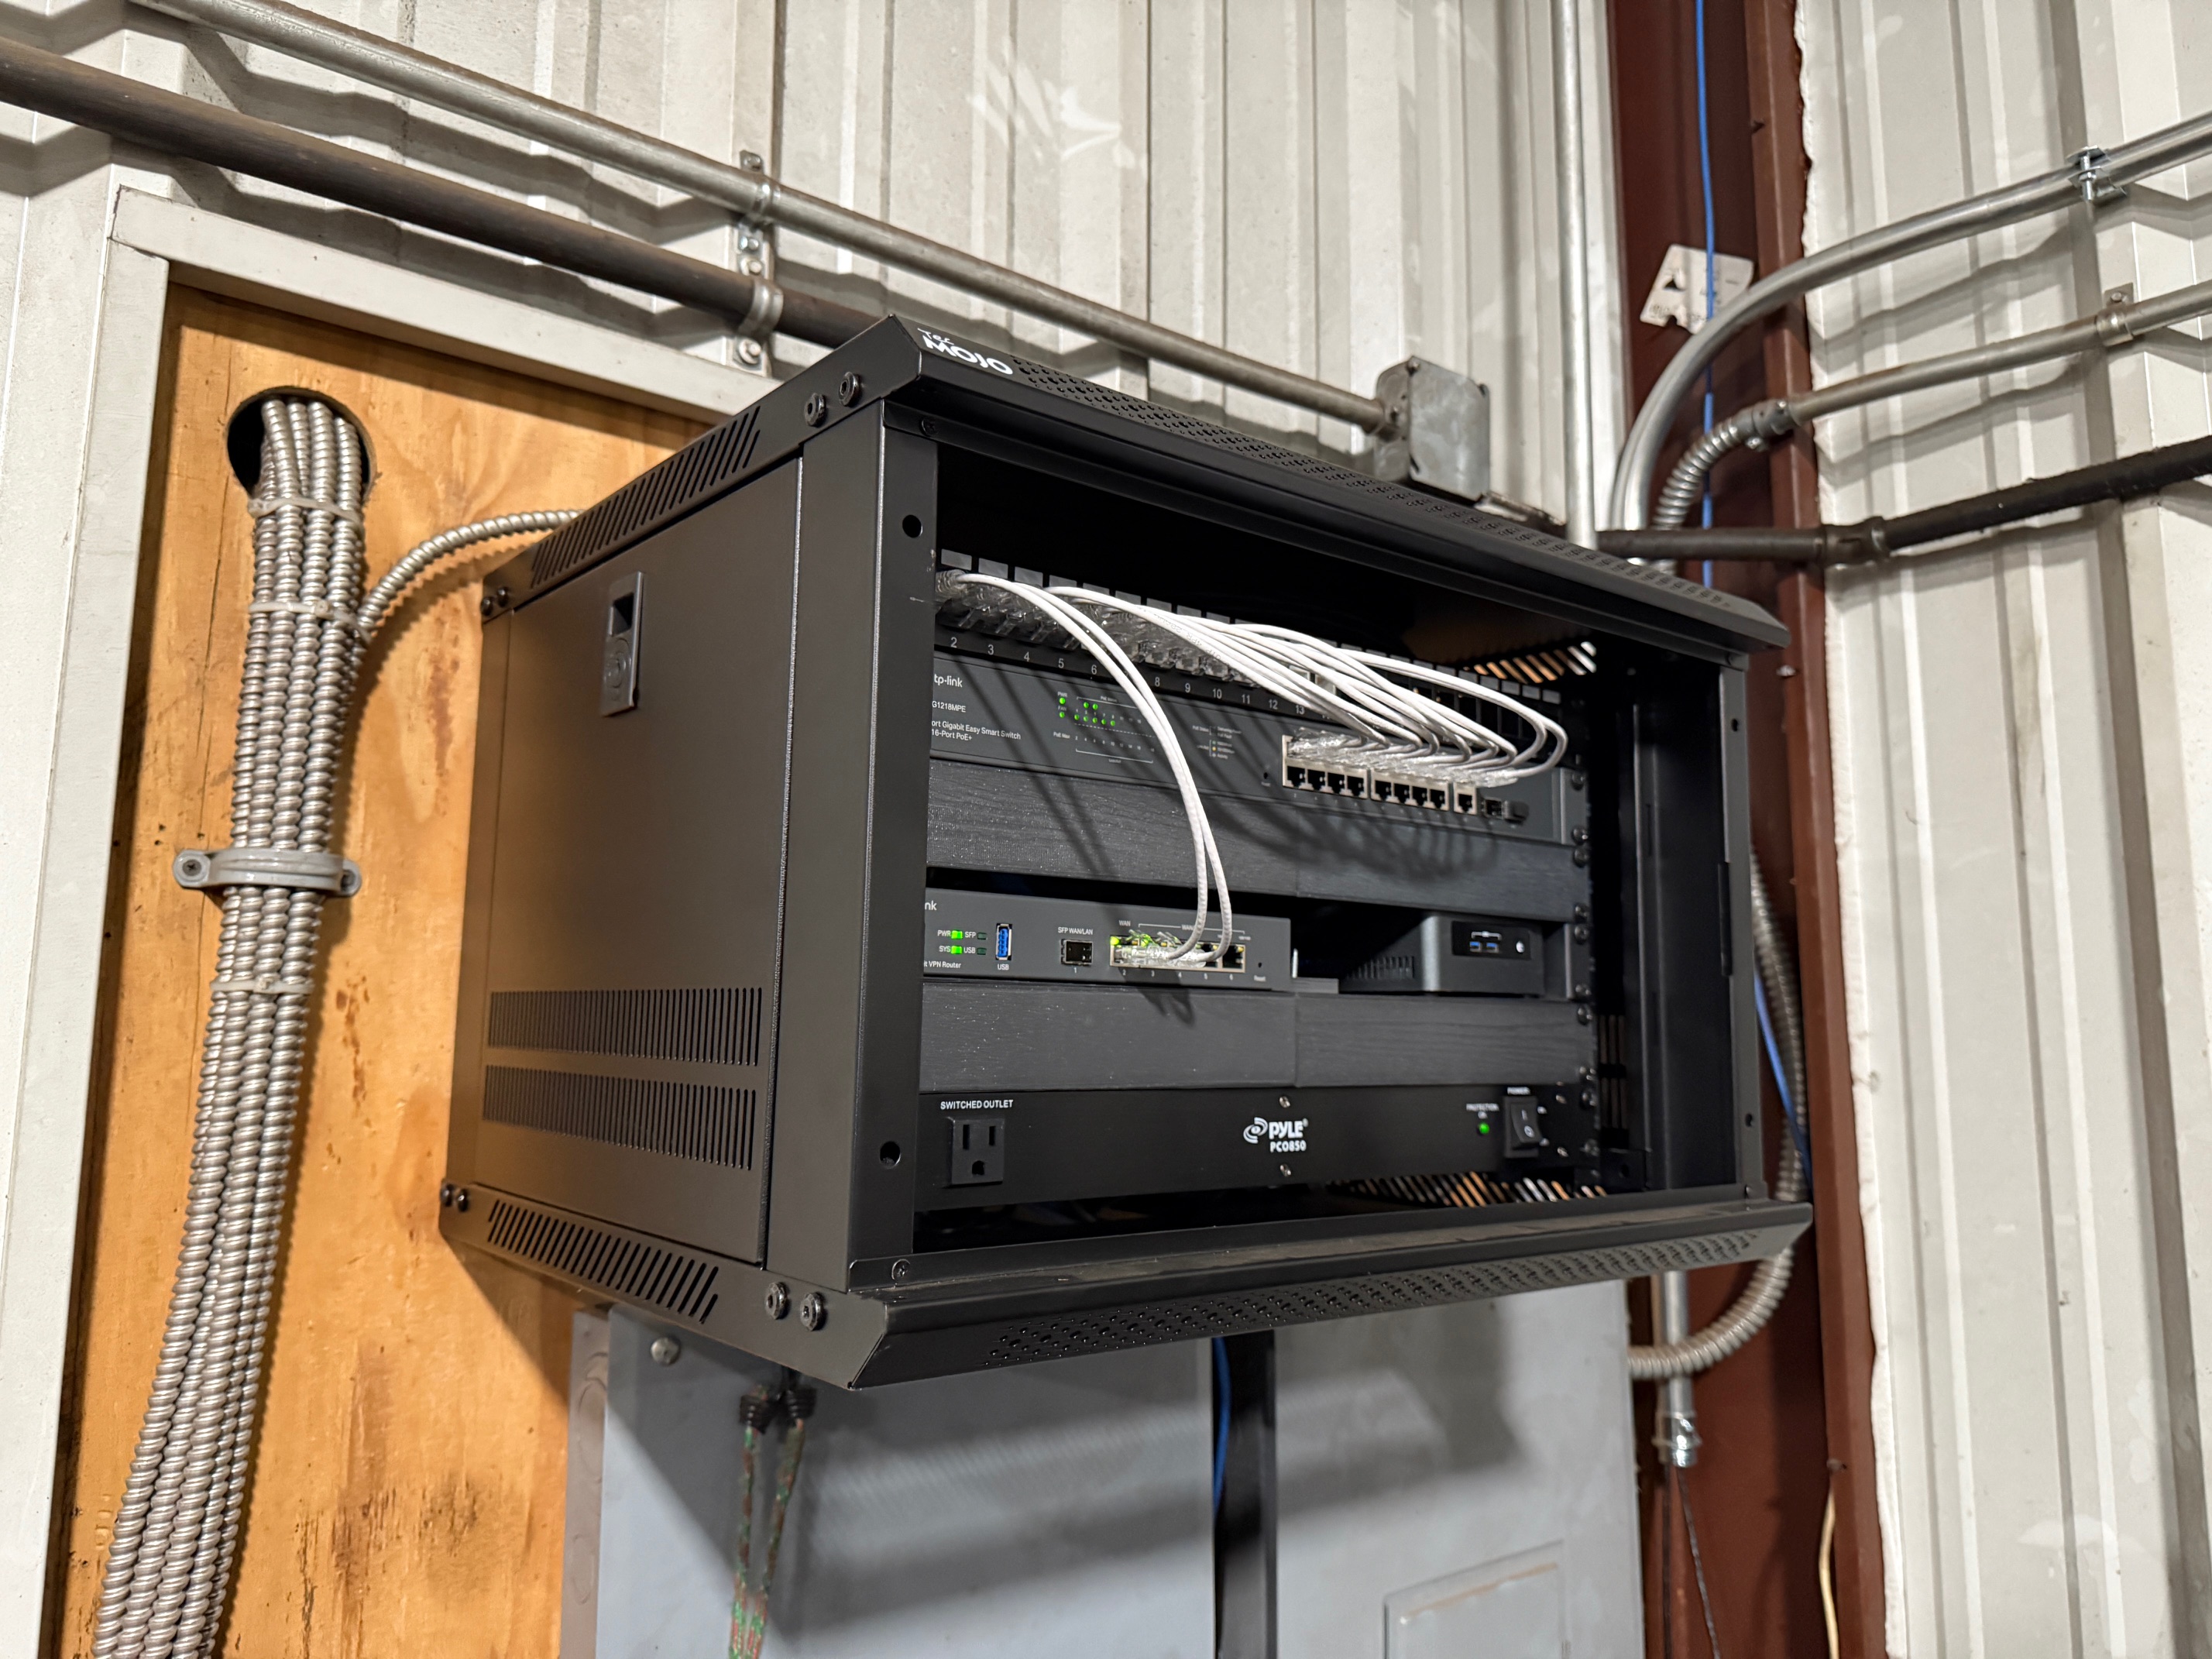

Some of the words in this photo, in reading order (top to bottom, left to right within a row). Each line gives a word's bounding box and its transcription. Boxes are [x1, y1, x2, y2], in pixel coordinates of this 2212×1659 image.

[922, 335, 1013, 375] MOJO
[934, 674, 963, 688] tp-link
[951, 637, 957, 648] 2
[988, 644, 994, 655] 3
[1024, 651, 1030, 662] 4
[1058, 658, 1064, 668] 5
[1091, 665, 1097, 675] 6
[1155, 677, 1160, 687] 8
[1185, 683, 1190, 693] 9
[1213, 689, 1222, 699] 10
[1242, 694, 1250, 704] 11
[1269, 699, 1277, 709] 12
[1296, 705, 1305, 715] 13
[932, 701, 966, 713] G1218MPE
[932, 729, 955, 739] 16-Port
[957, 732, 972, 740] PoE+
[943, 721, 964, 731] Gigabit
[966, 725, 981, 734] Easy
[981, 727, 999, 737] Smart
[1001, 730, 1021, 740] Switch
[940, 1101, 982, 1110] SWITCHED
[983, 1099, 1014, 1108] OUTLET
[1269, 1121, 1304, 1139] PYLE
